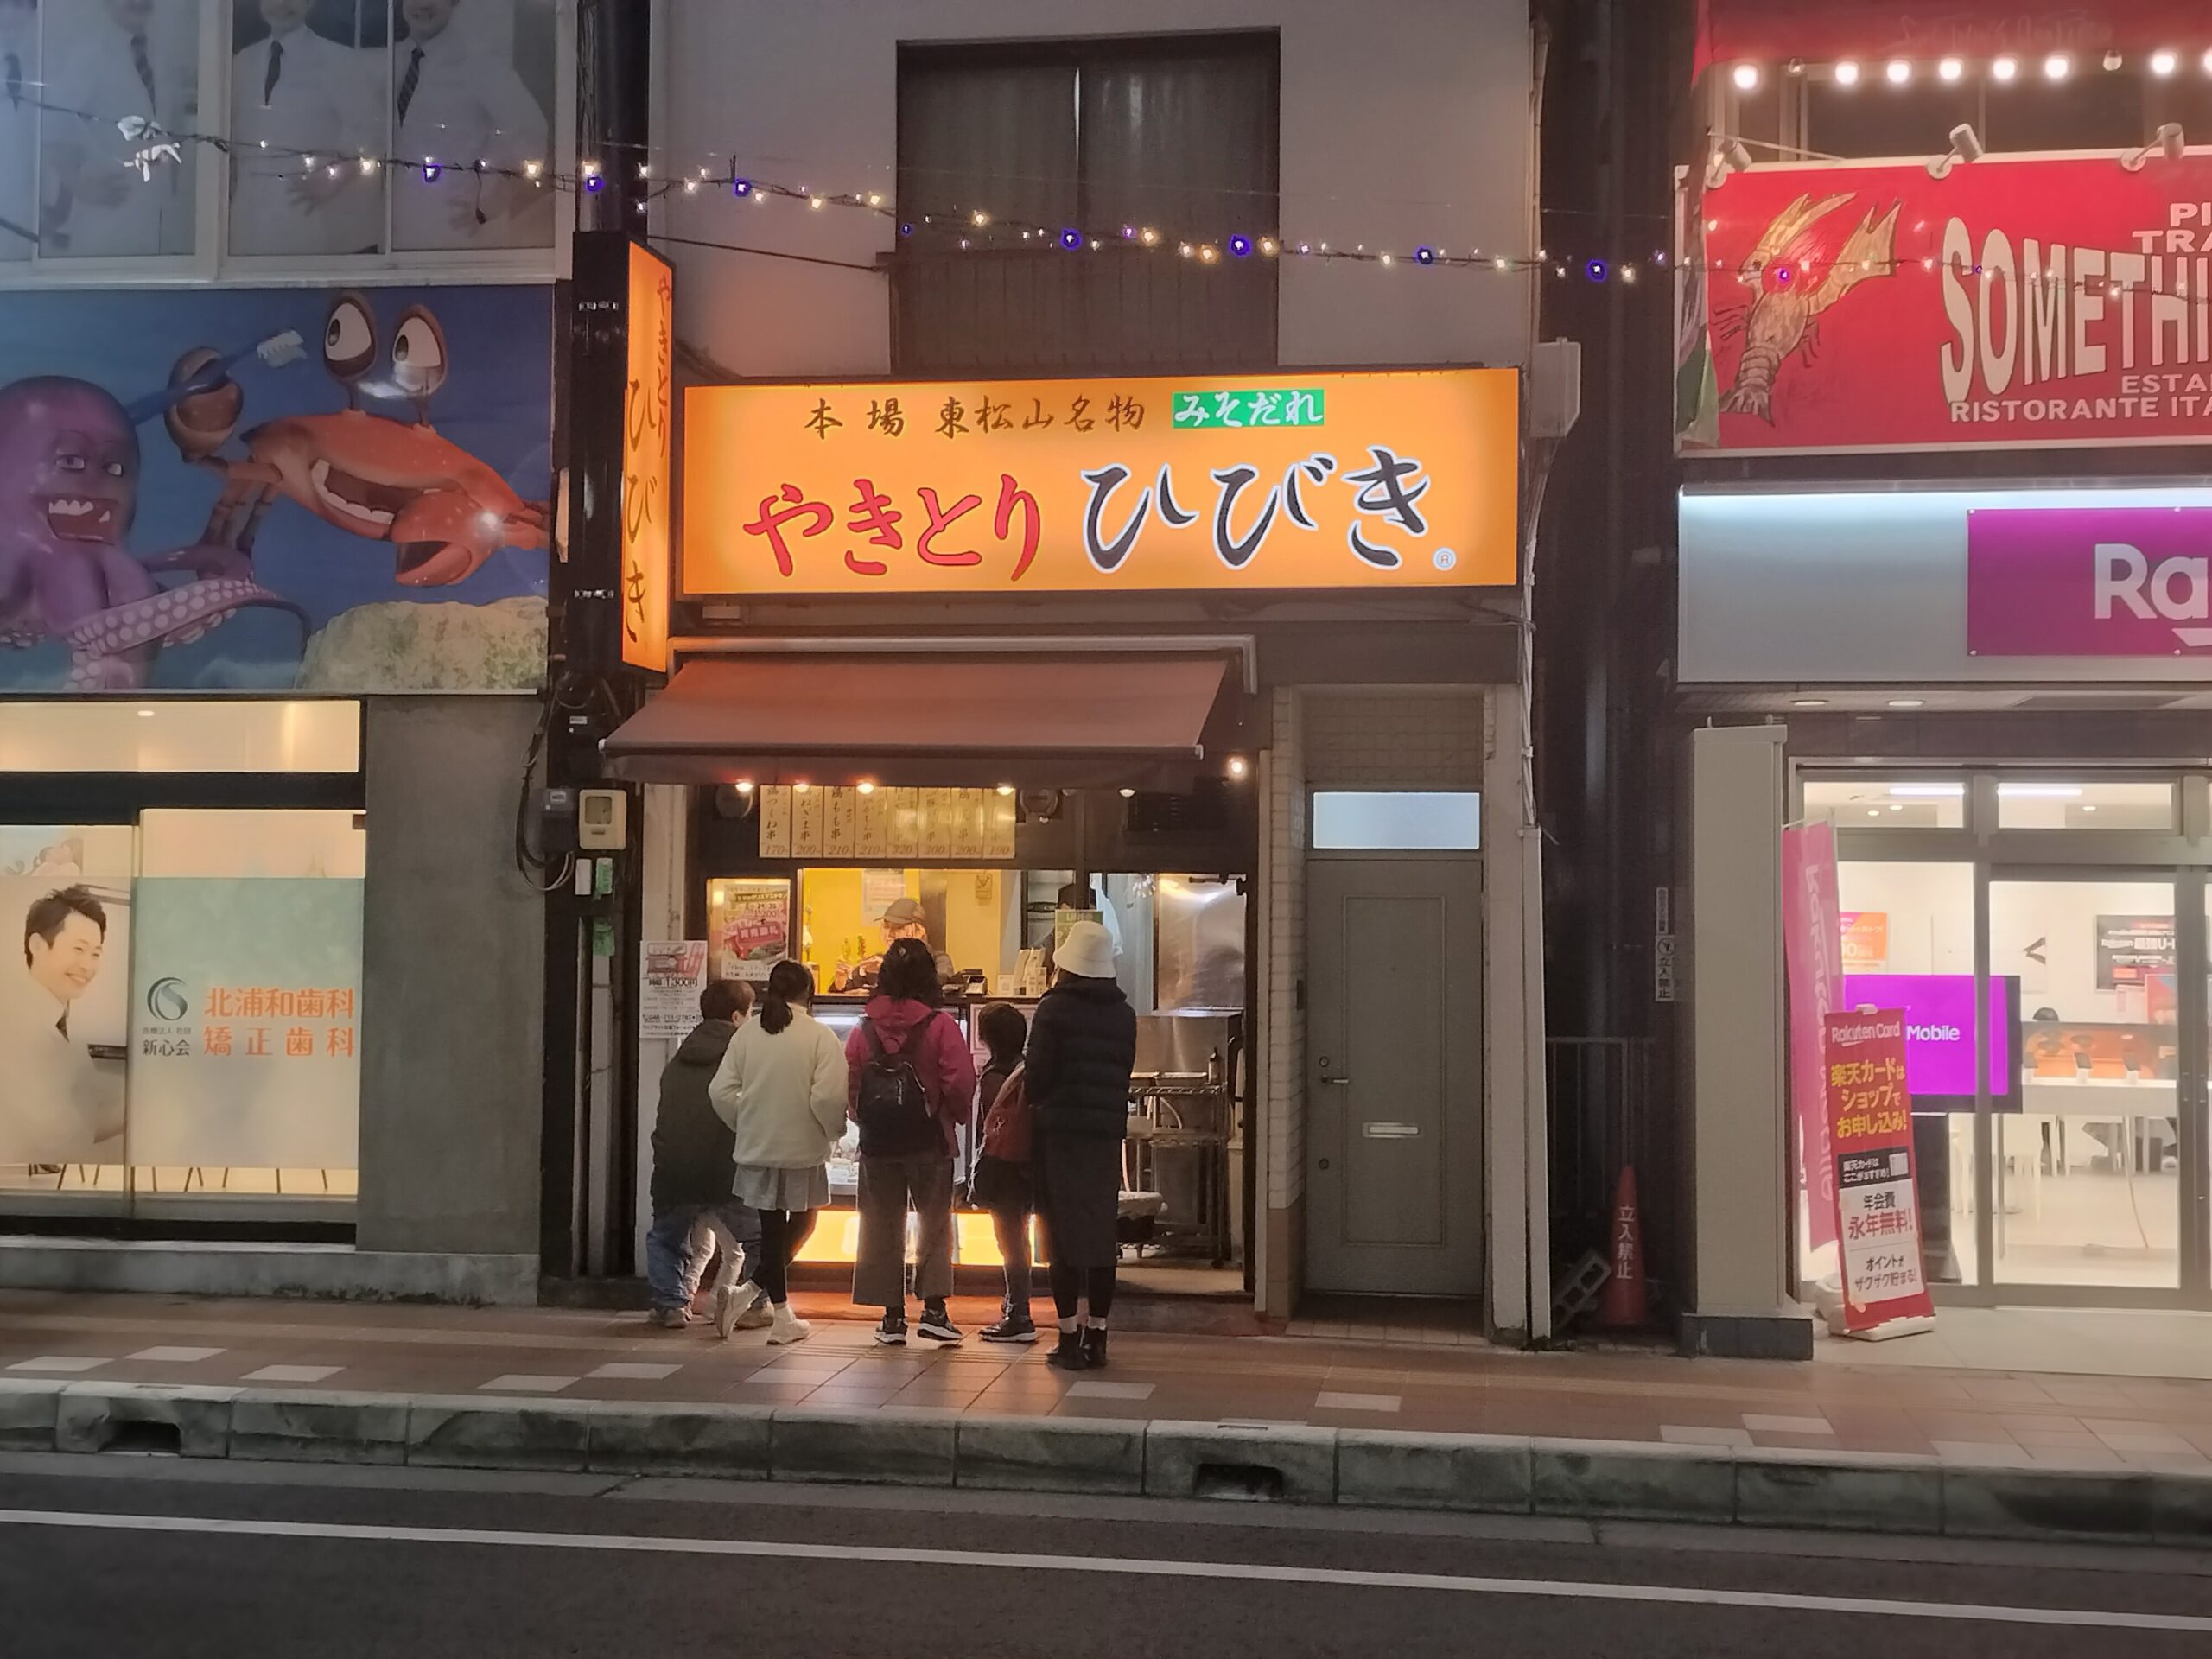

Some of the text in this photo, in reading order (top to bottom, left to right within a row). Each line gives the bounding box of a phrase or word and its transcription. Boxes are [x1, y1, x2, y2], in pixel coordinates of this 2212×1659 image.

[657, 274, 671, 459] やきとり
[2121, 373, 2212, 394] ESTA
[933, 393, 1146, 439] 東松山名物
[1173, 390, 1323, 427] みそだれ
[1951, 397, 2159, 423] RISTORANTE
[626, 378, 657, 644] ひびき
[1079, 443, 1432, 575] ひびき
[742, 473, 1043, 581] やきとり
[2094, 543, 2209, 620] Ra
[204, 988, 354, 1019] 北浦和歯科
[143, 1039, 191, 1056] 新心会
[203, 1026, 354, 1058] 矯正歯科
[1831, 1021, 1900, 1043] Rakuten Card
[1906, 1025, 1961, 1041] Mobile
[1830, 1057, 1906, 1087] 楽天カードは
[1841, 1082, 1901, 1112] ショップで
[1837, 1109, 1908, 1139] お申し込み!
[1864, 1191, 1896, 1210] 年会費
[1848, 1208, 1913, 1240] 永年無料!
[1616, 1205, 1636, 1279] 立入禁止
